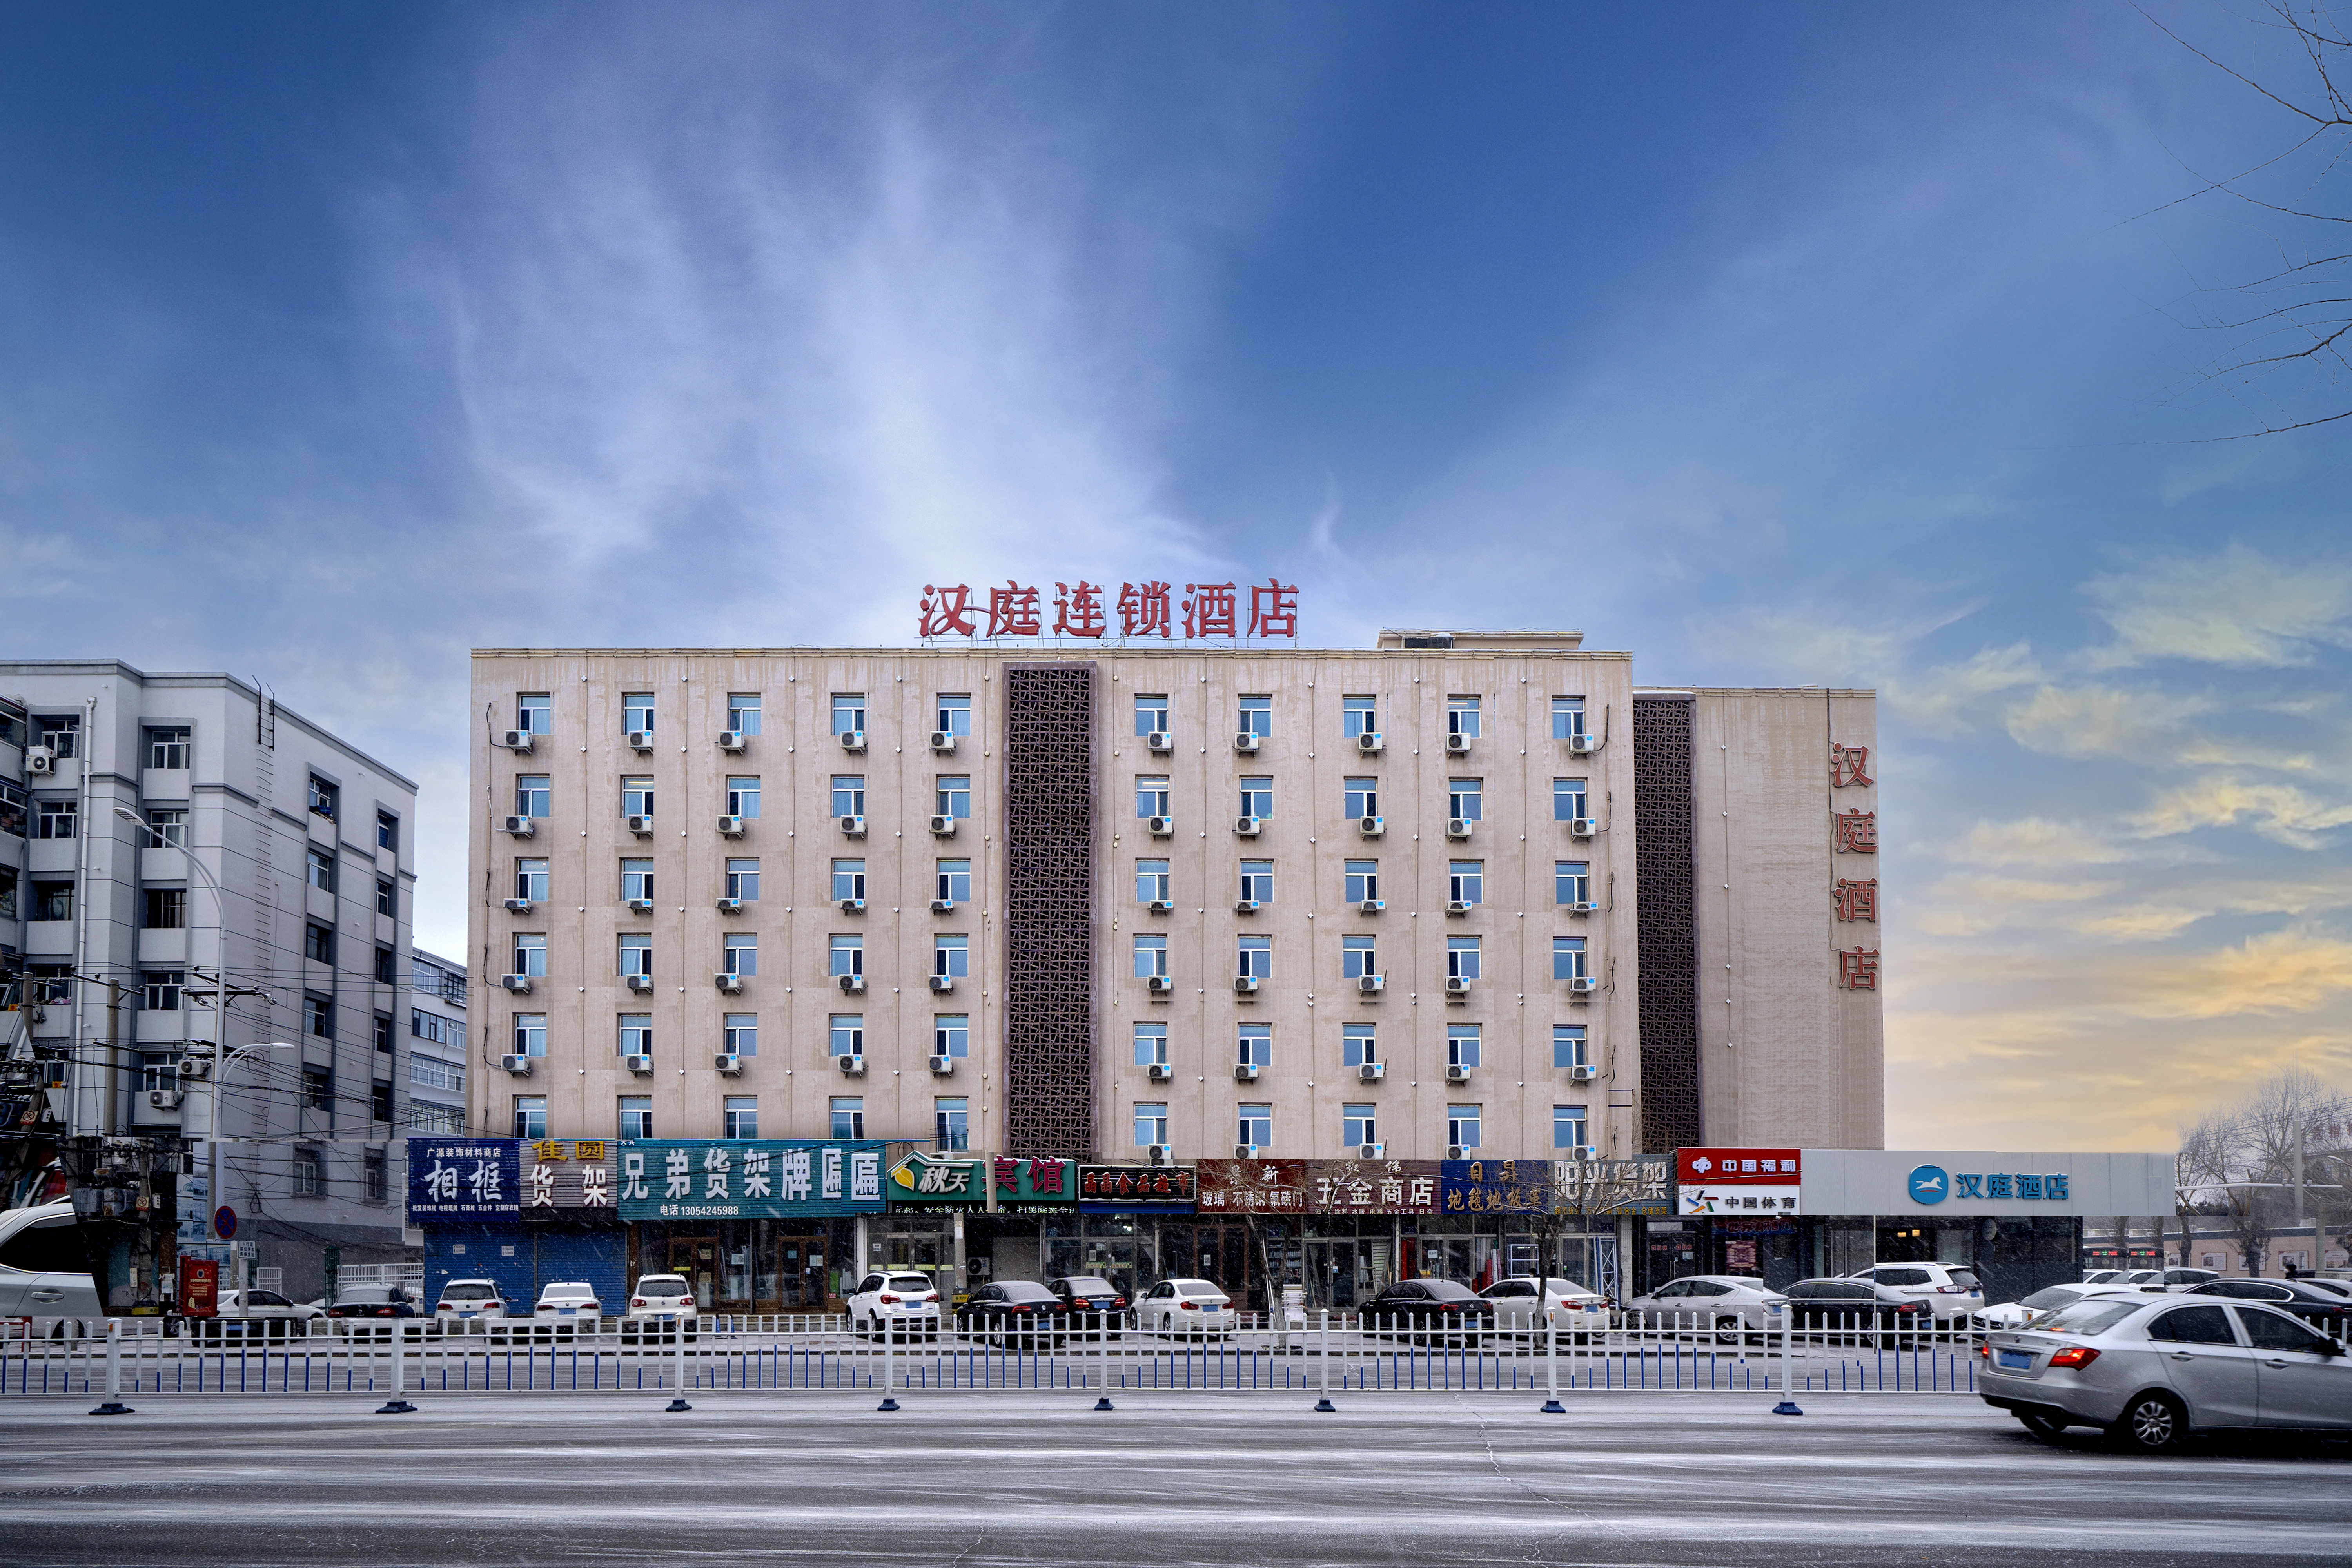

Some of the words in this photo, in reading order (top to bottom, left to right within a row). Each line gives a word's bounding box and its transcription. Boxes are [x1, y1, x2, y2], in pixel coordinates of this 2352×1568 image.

[918, 578, 1300, 638] 汉庭连锁酒店
[1831, 742, 1880, 989] 汉庭酒店
[427, 1147, 501, 1158] 广源装饰材料商店
[1722, 1159, 1796, 1172] 中国福利
[424, 1160, 502, 1203] 相框
[530, 1164, 608, 1207] 货架
[918, 1166, 970, 1193] 秋天
[981, 1154, 1066, 1194] 宾馆
[1554, 1161, 1667, 1200] 阳光货架
[1956, 1171, 2069, 1200] 汉庭酒店
[1202, 1191, 1225, 1207] 玻璃
[1315, 1176, 1434, 1206] 五金商店
[1726, 1196, 1796, 1209] 中国体育
[660, 1205, 679, 1216] 电话
[681, 1206, 739, 1216] 13054245988
[1641, 1207, 1667, 1215] 仓储货架
